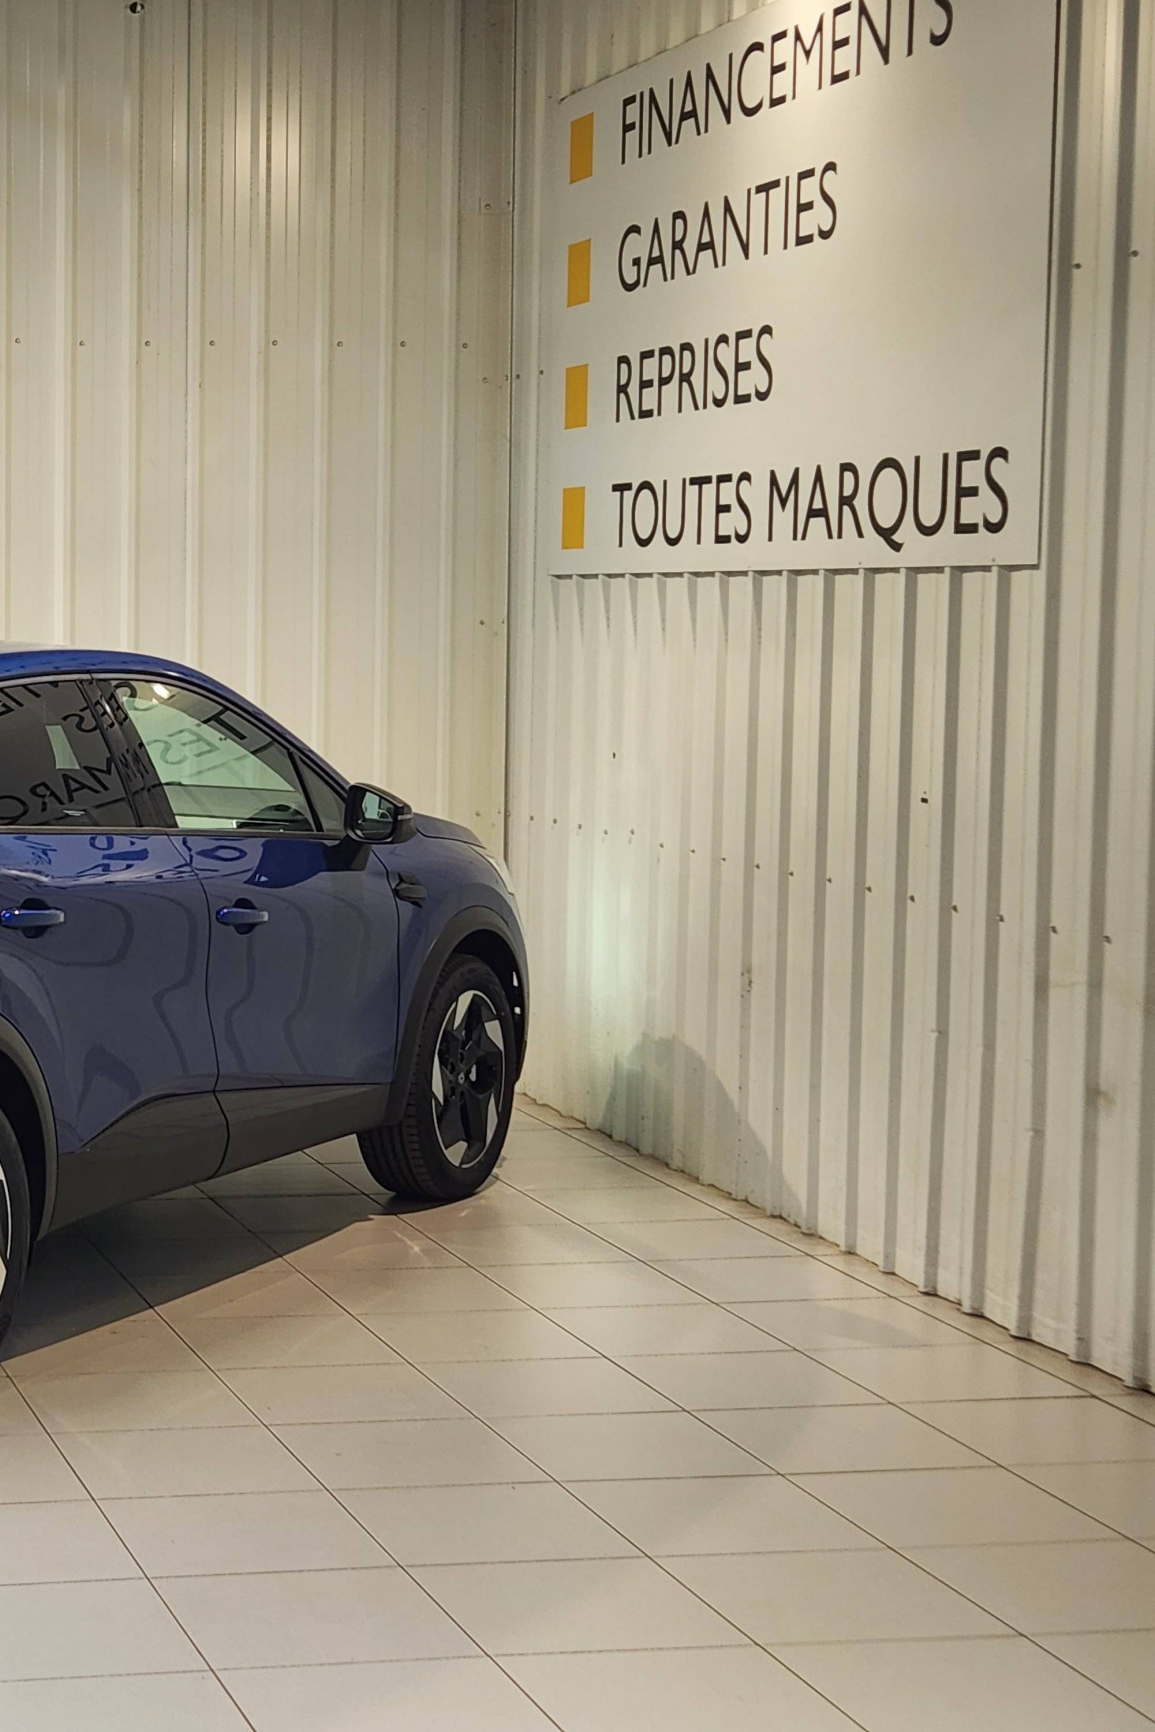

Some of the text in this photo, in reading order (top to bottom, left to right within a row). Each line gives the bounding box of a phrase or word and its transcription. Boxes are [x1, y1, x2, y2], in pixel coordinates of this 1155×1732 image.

[617, 161, 838, 292] GARANTIES
[615, 324, 773, 423] REPRISES
[611, 446, 1009, 552] TOUTES MARQUES
